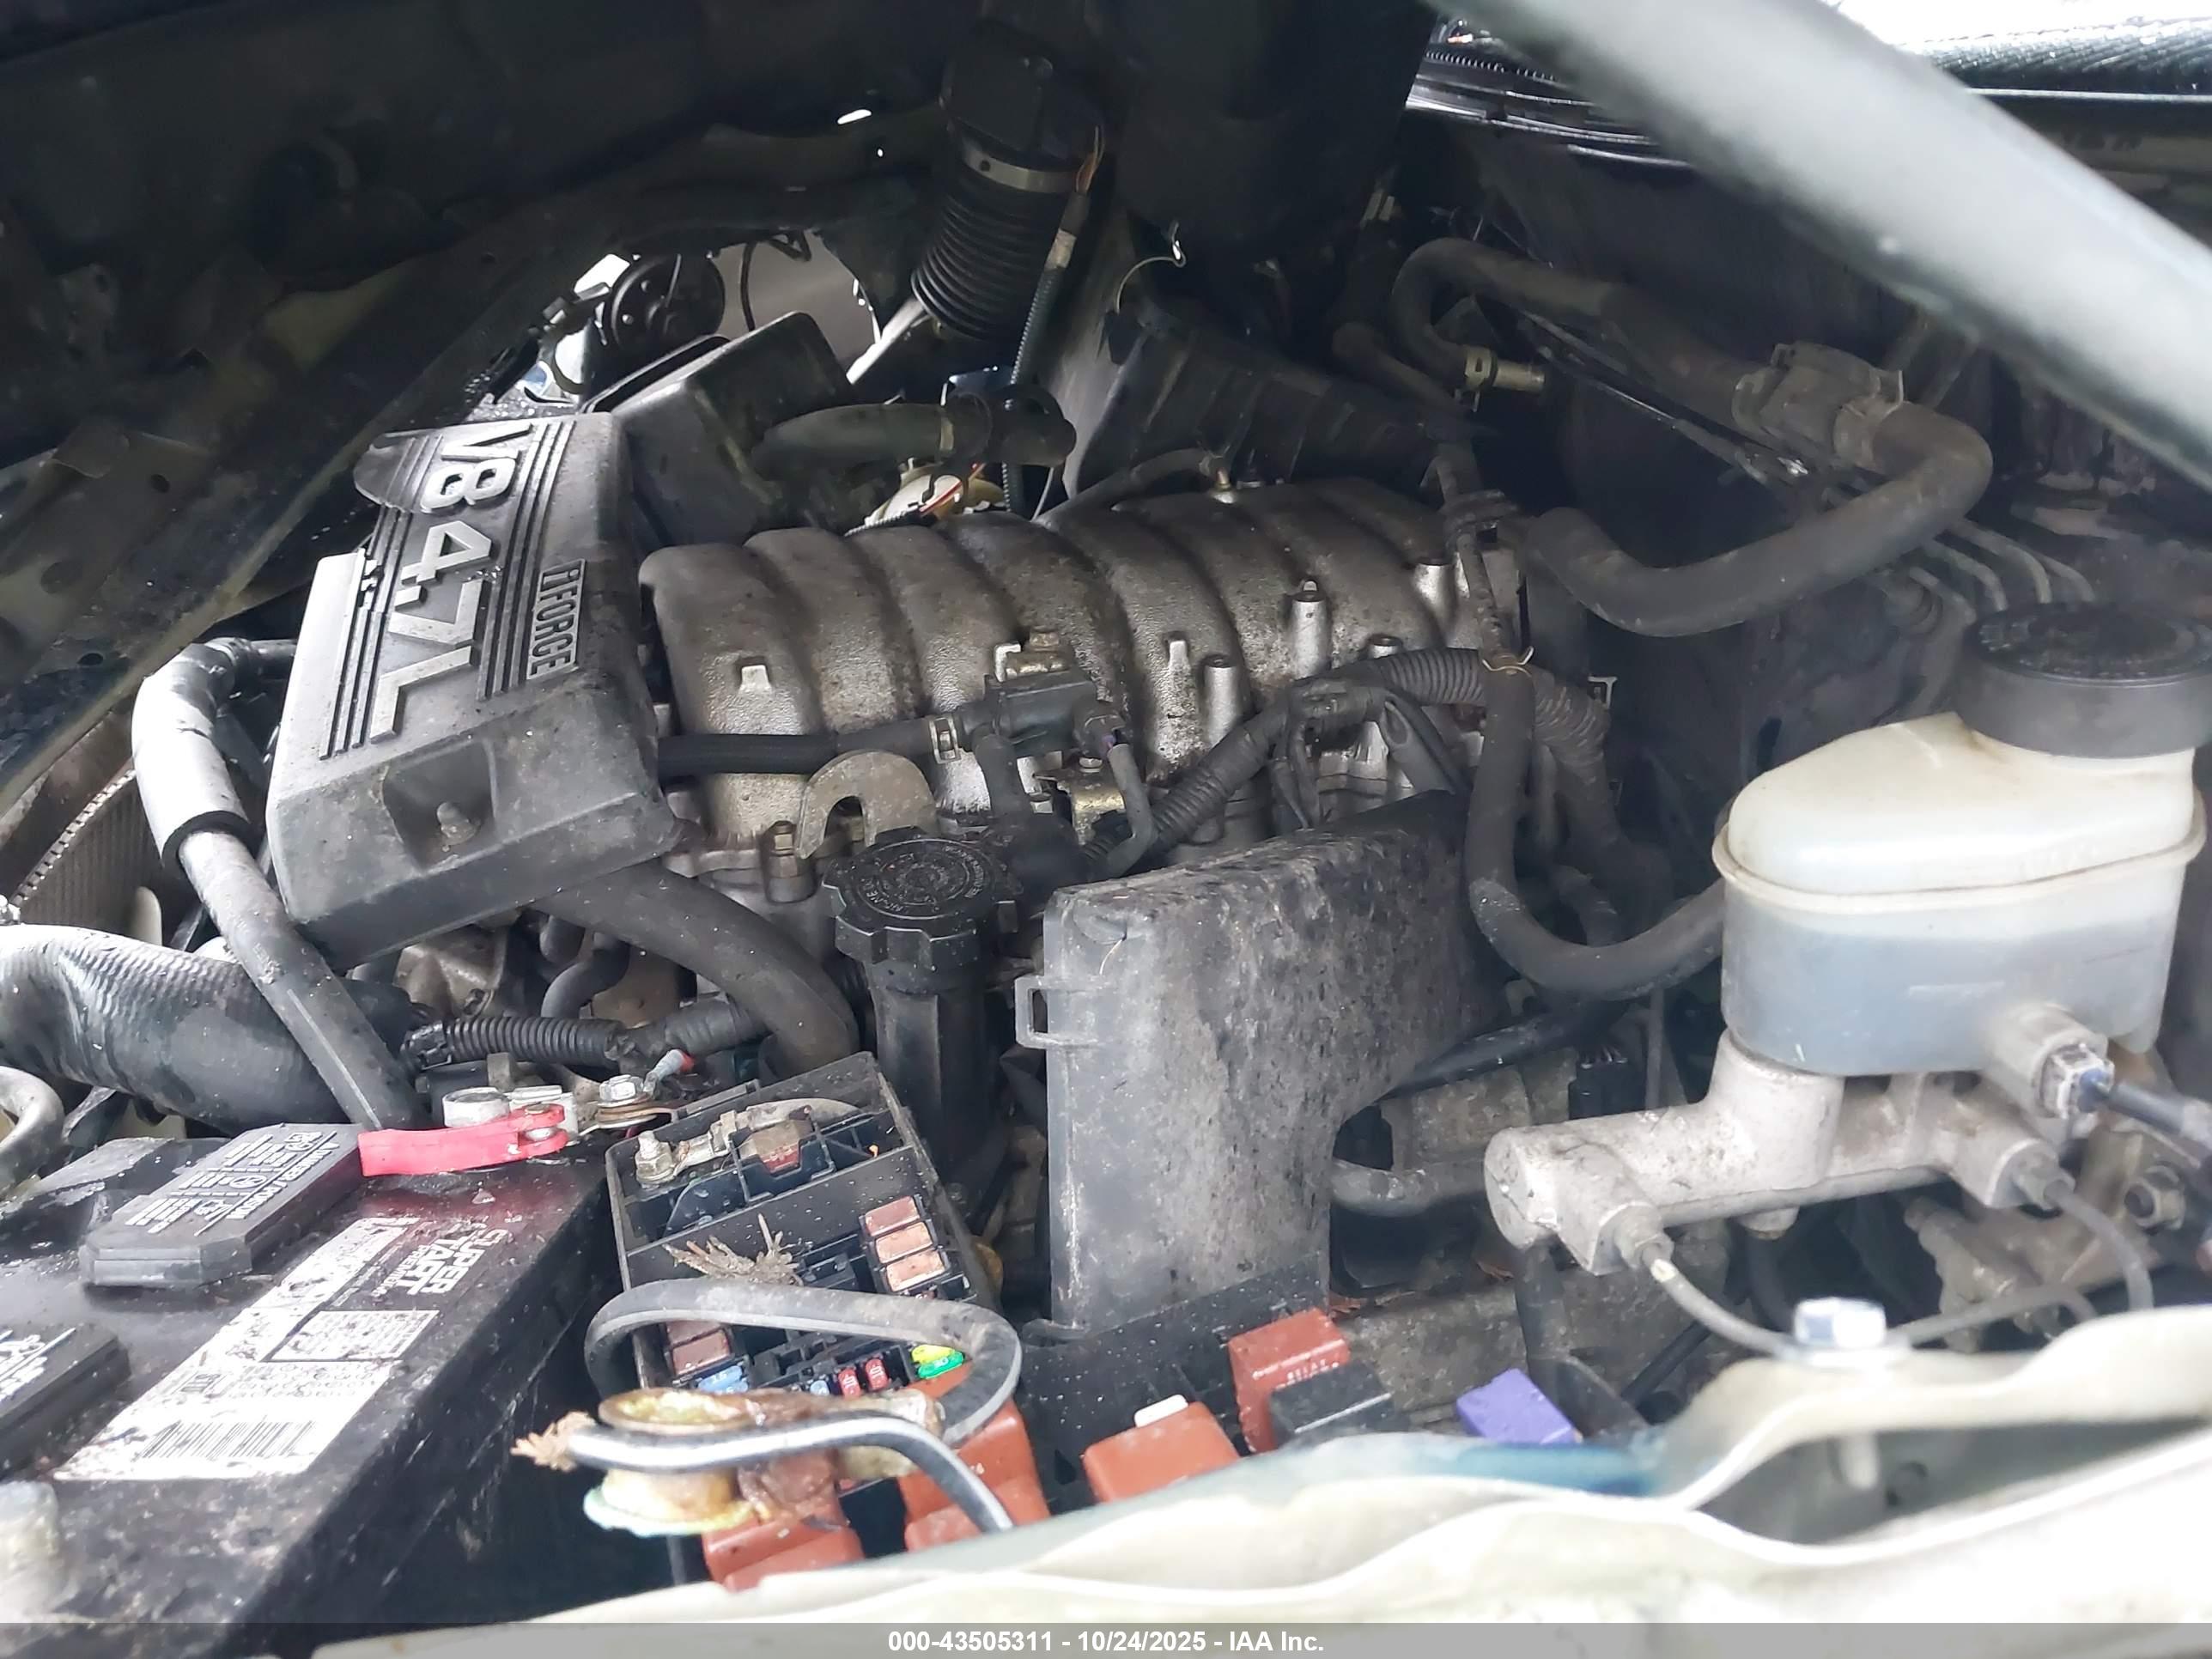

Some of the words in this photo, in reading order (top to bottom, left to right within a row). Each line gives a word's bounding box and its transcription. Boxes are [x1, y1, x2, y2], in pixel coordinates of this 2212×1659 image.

[420, 421, 533, 514] V8
[369, 520, 493, 744] 4.7L
[420, 1229, 509, 1294] SUPER
